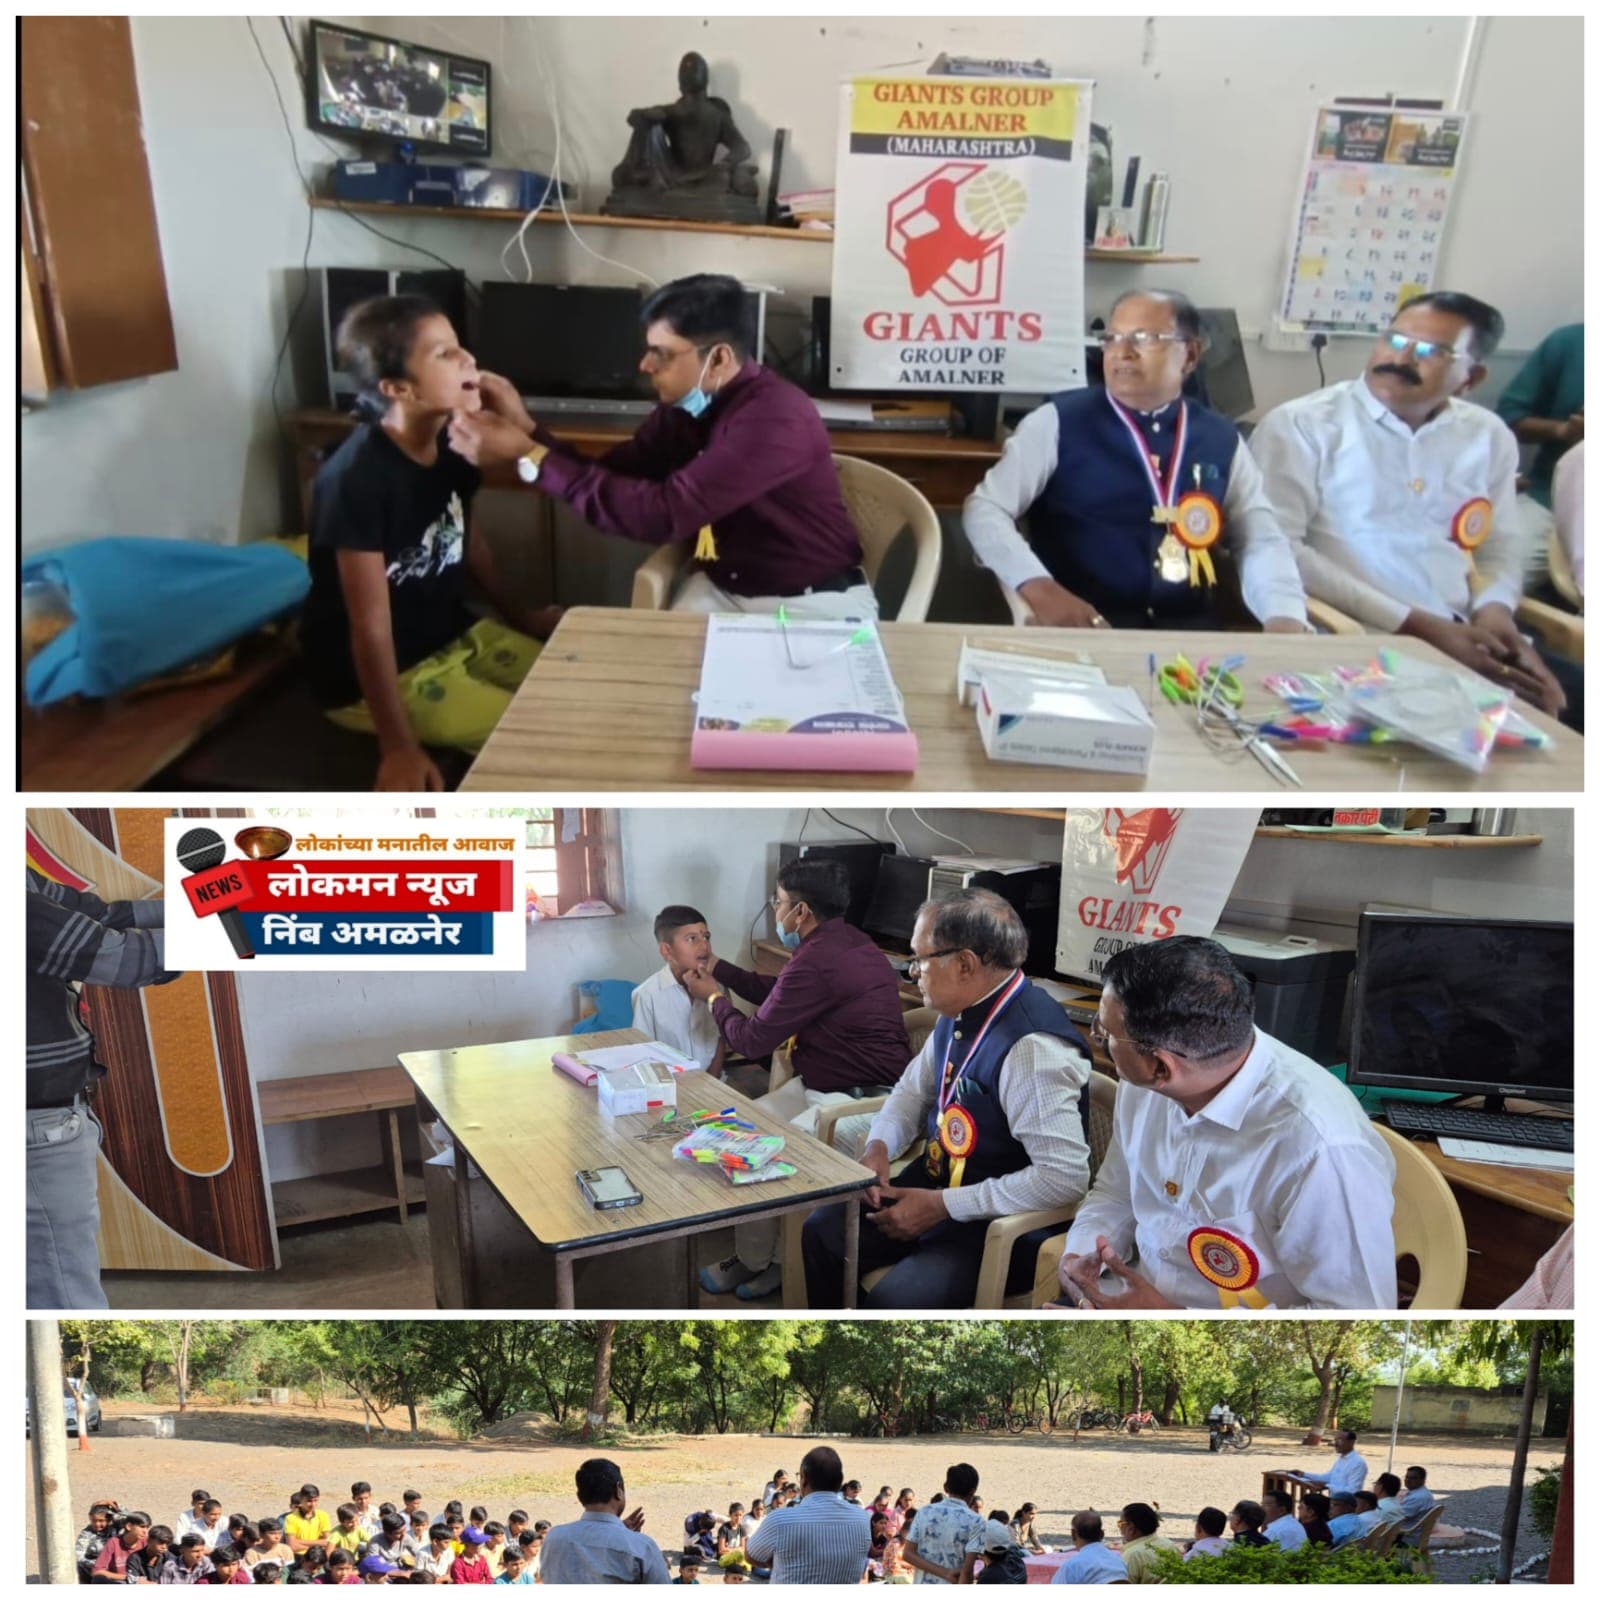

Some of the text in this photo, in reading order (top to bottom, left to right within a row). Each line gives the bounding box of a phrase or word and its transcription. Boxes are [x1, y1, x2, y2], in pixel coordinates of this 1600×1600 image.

[874, 83, 1054, 107] GIANTS GROUP
[897, 110, 1027, 132] AMALNER
[886, 136, 1036, 156] (MAHARASHTRA)
[863, 311, 1042, 342] GIANTS
[900, 347, 1006, 364] GROUP OF
[898, 369, 1005, 386] AMALNER
[1078, 896, 1182, 939] GIANTS
